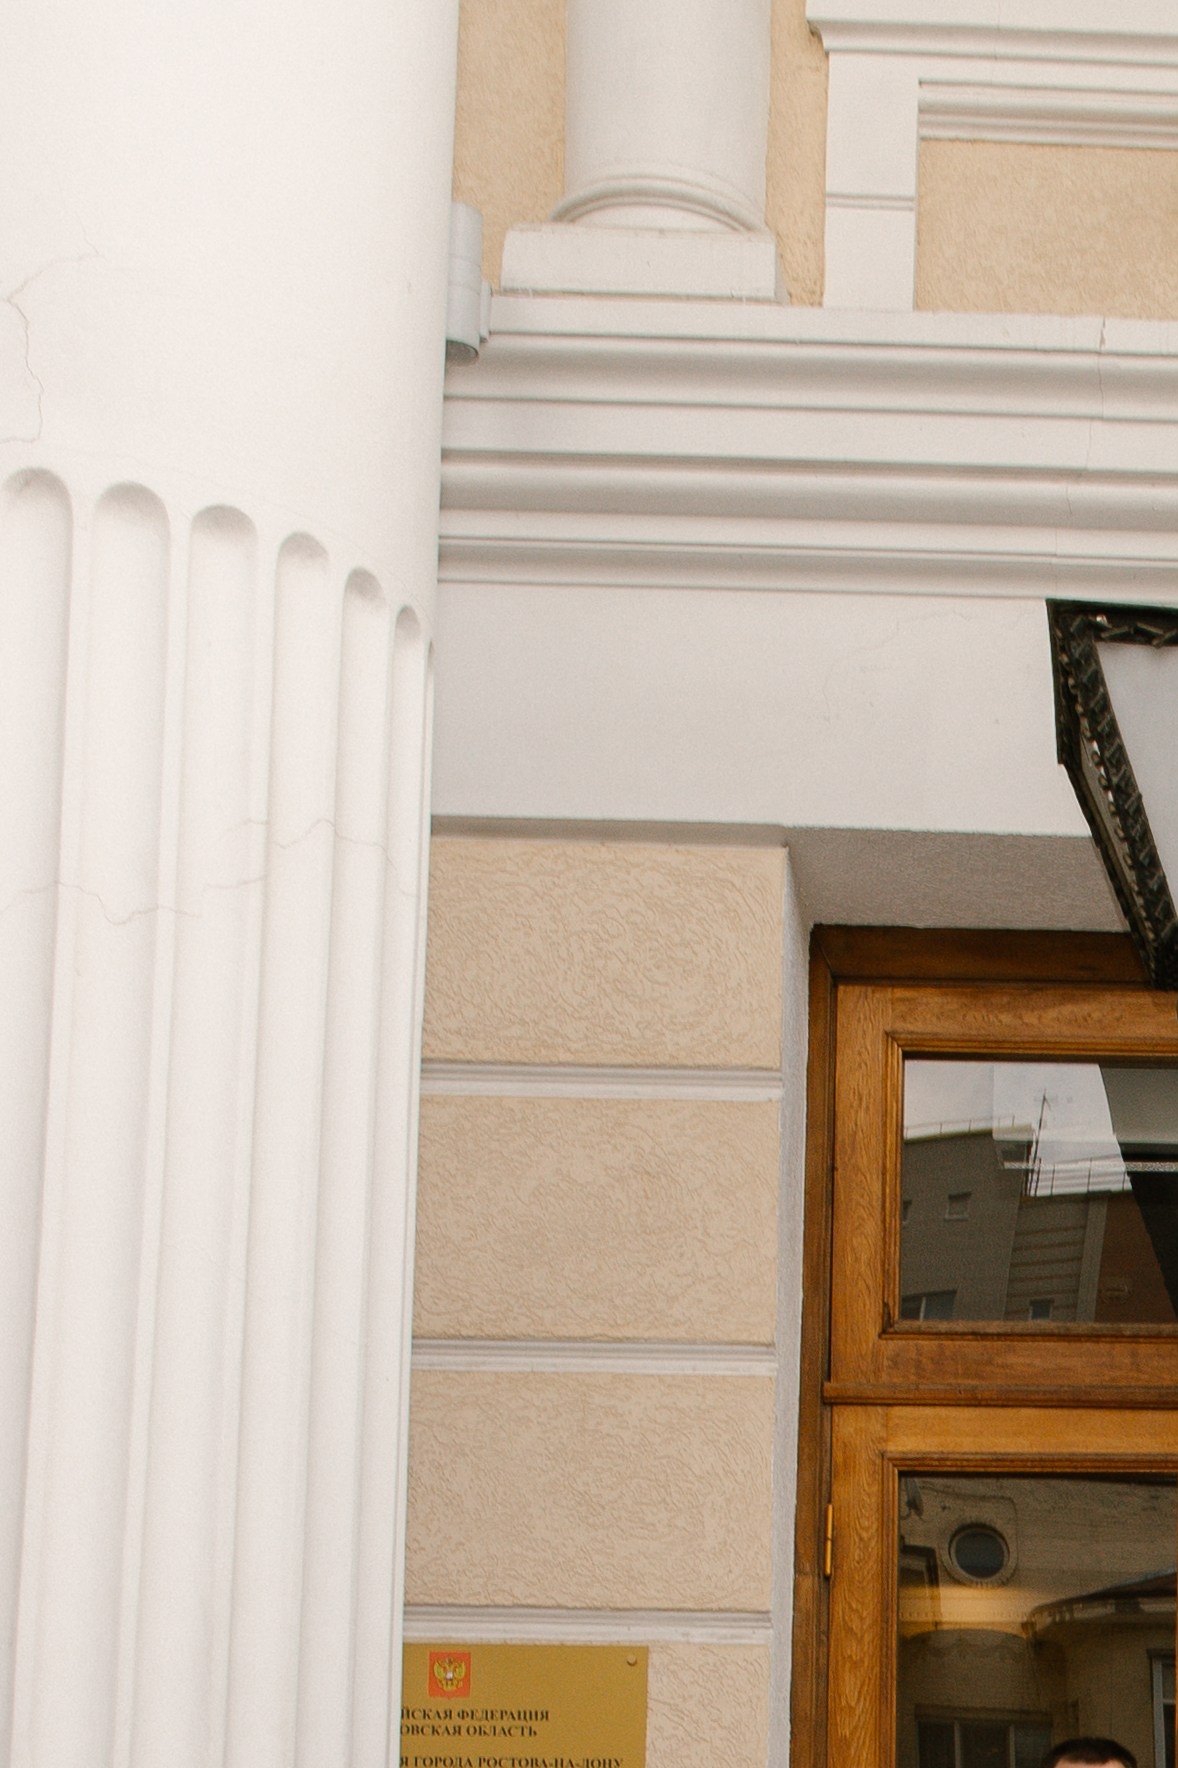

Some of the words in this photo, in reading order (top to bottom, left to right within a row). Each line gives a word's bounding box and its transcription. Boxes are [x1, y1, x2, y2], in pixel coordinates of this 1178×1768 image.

[457, 1709, 550, 1721] ФЕДЕРАЦИЯ
[466, 1725, 537, 1737] ОБЛАСТЬ
[414, 1757, 473, 1768] ГОРОДА
